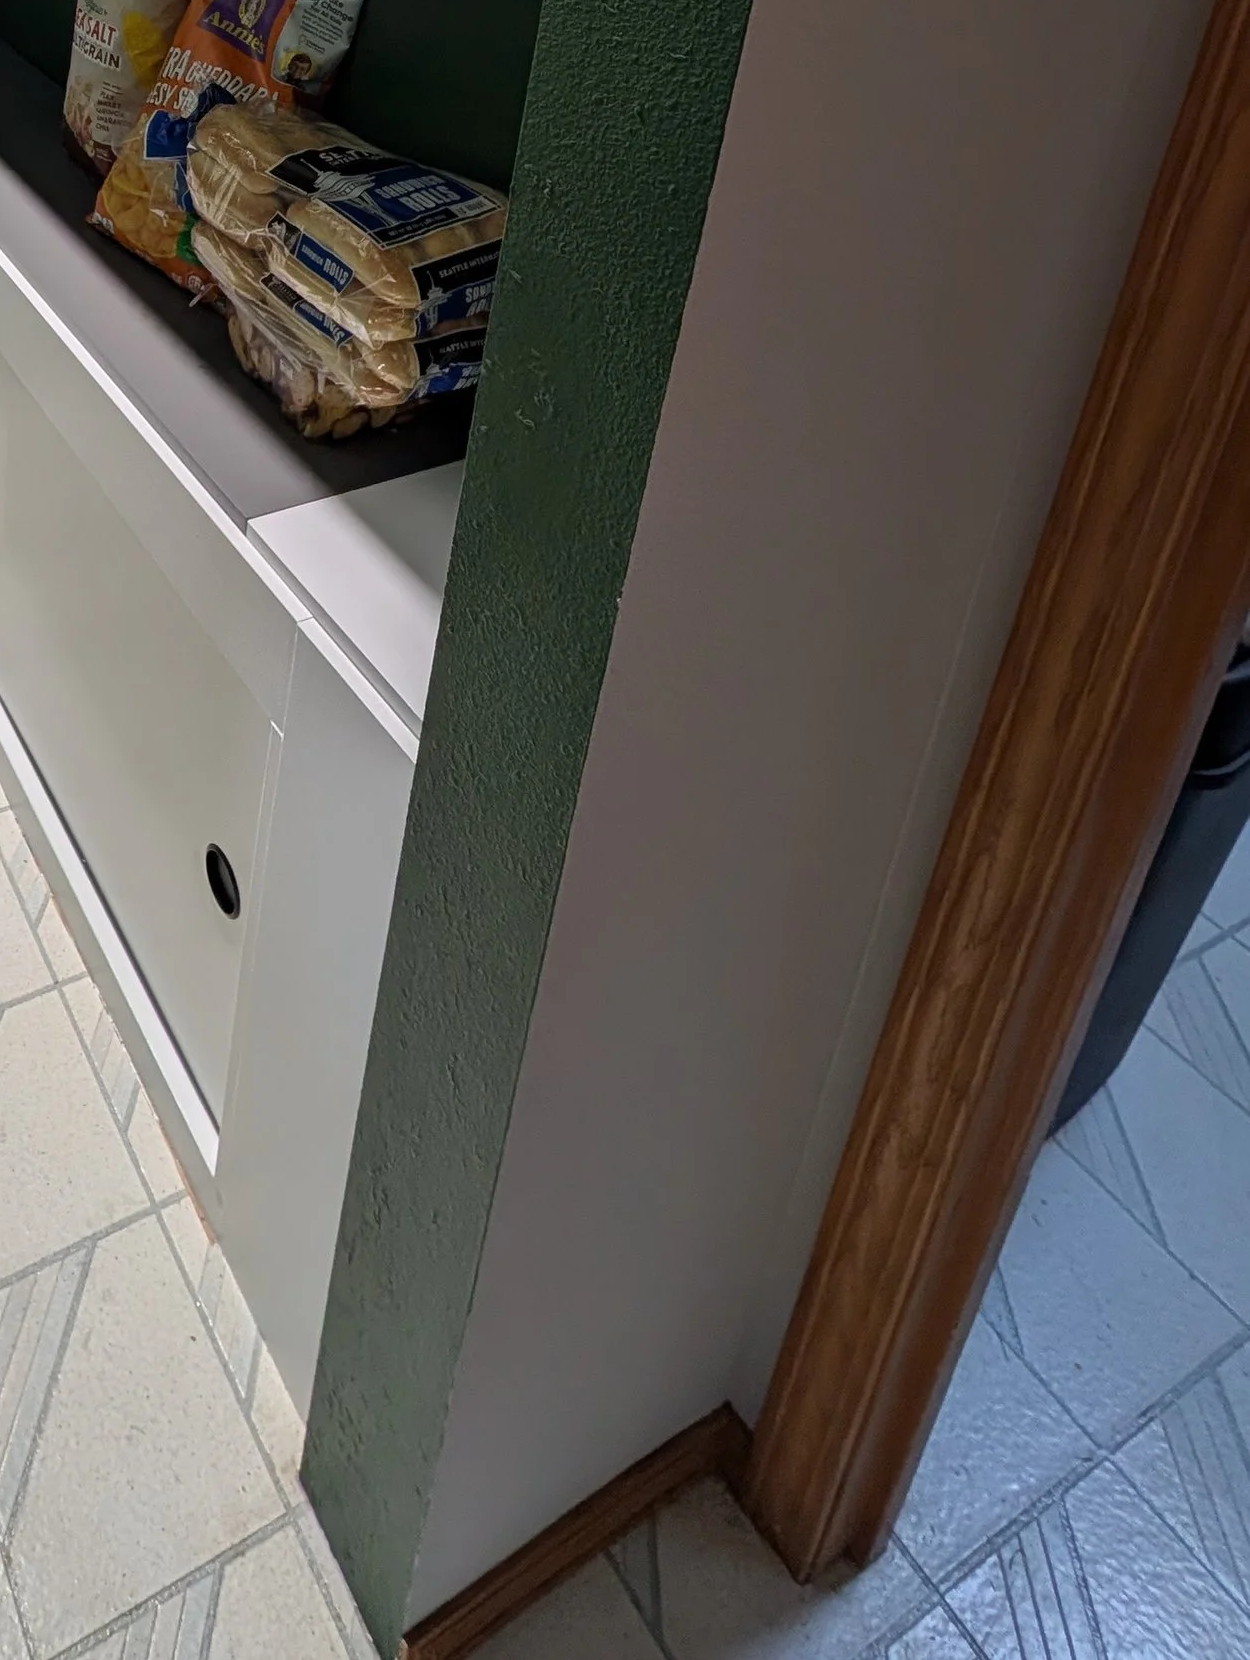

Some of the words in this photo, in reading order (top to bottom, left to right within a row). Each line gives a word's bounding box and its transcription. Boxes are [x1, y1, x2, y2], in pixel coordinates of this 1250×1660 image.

[320, 0, 354, 22] Change
[86, 16, 117, 47] SALT
[204, 12, 265, 55] Annie's
[398, 185, 461, 213] ROLLS
[323, 258, 349, 285] ROLLS
[438, 260, 469, 278] SEATTLE
